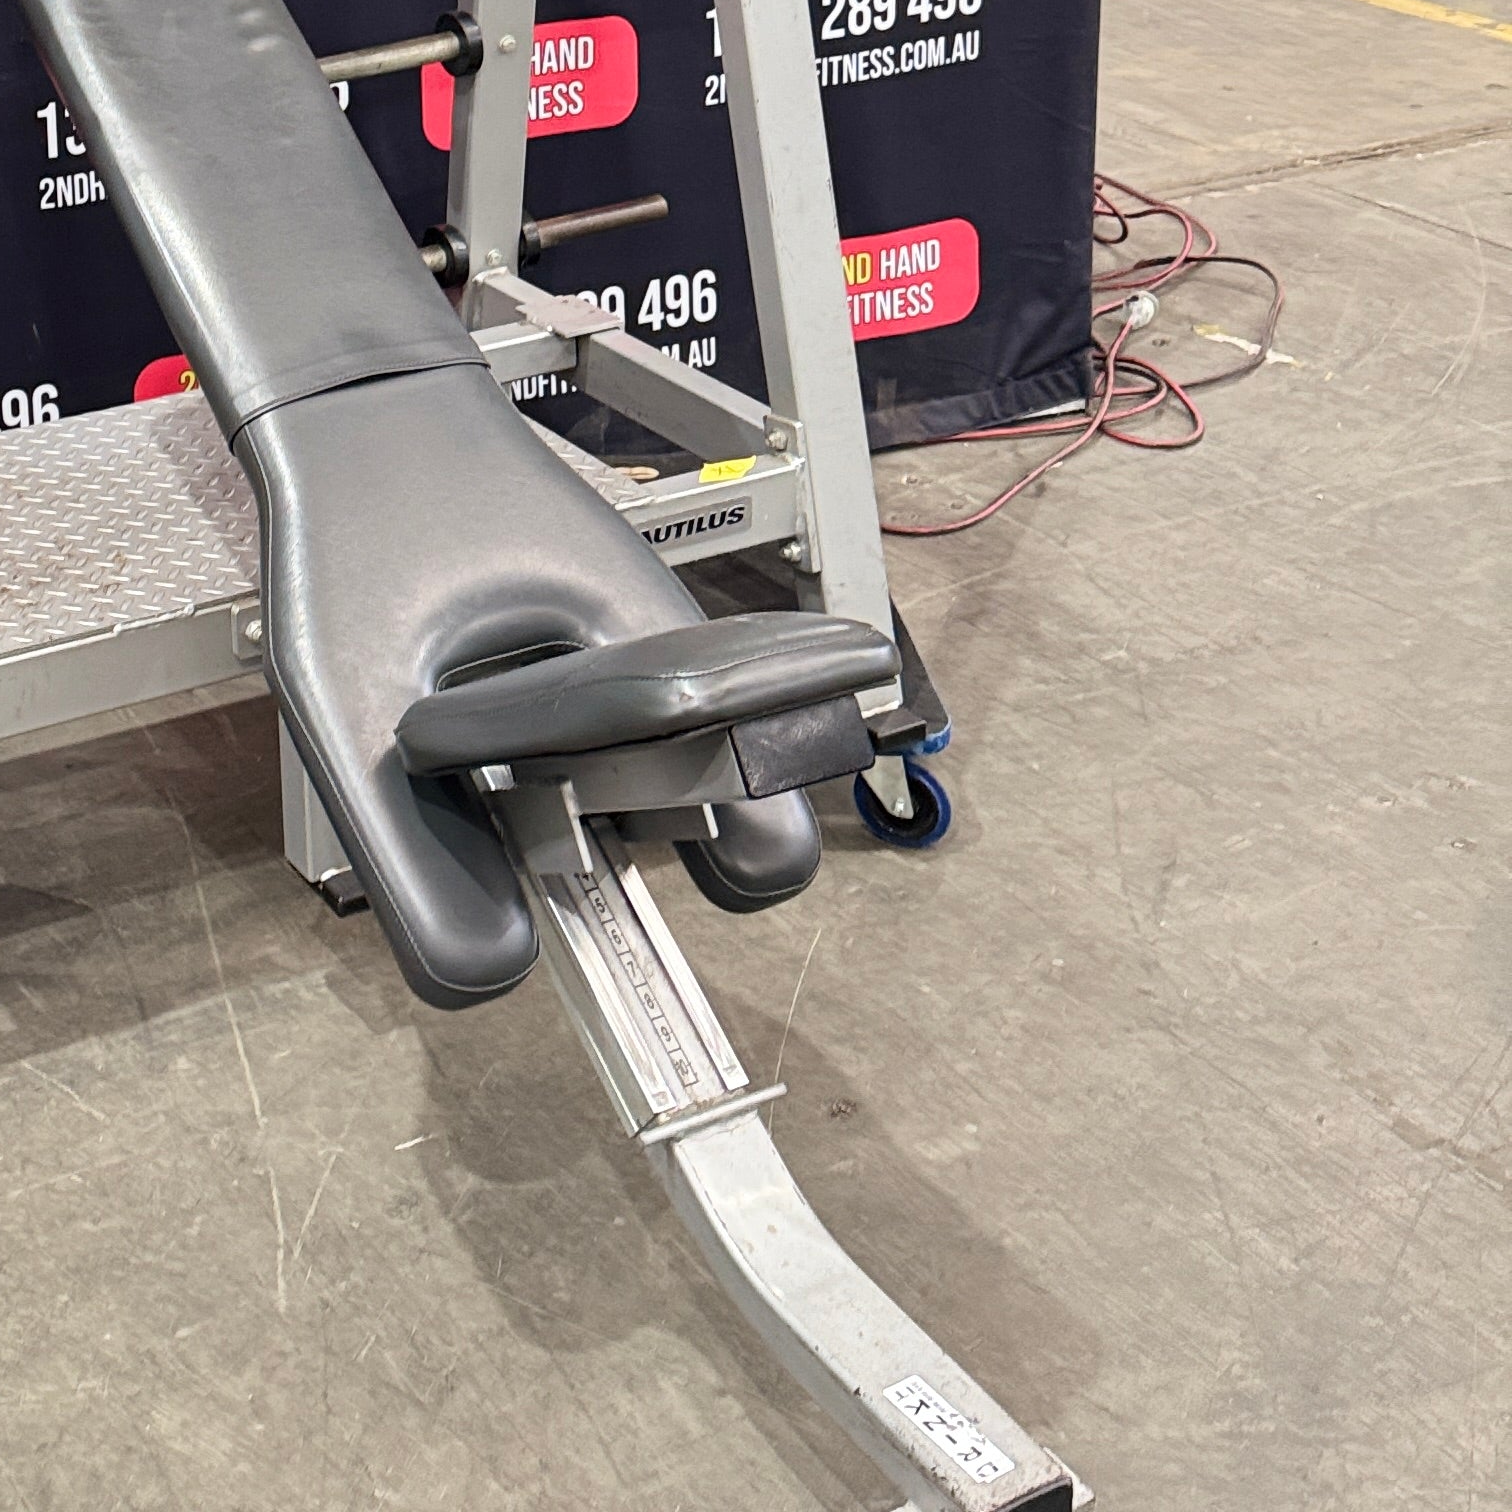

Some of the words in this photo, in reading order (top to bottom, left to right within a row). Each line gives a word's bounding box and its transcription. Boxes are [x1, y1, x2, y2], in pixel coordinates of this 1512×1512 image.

[528, 81, 584, 120] NESS
[881, 240, 940, 280] HAND
[638, 270, 716, 331] 496
